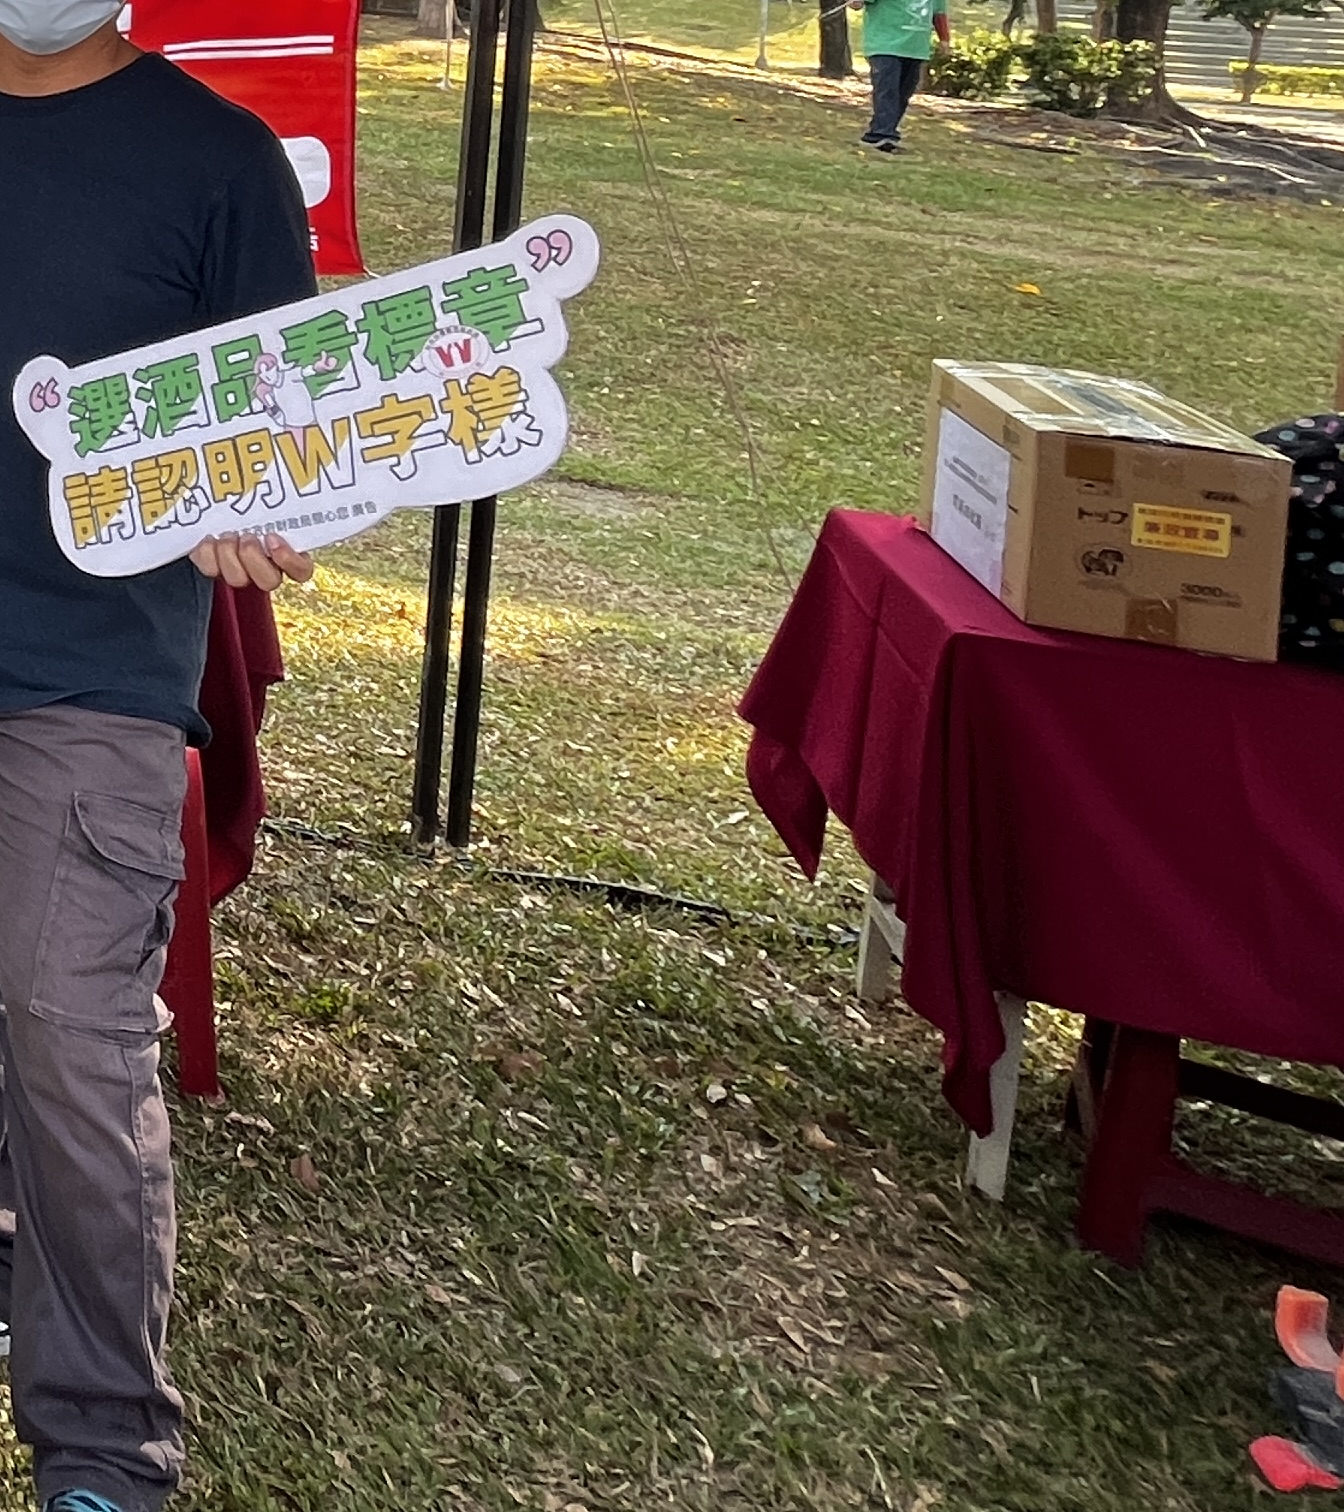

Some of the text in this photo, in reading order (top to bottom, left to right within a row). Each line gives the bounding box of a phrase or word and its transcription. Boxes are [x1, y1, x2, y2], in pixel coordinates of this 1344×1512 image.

[67, 263, 544, 458] 選酒品看標章
[62, 365, 543, 549] 請認明W字樣
